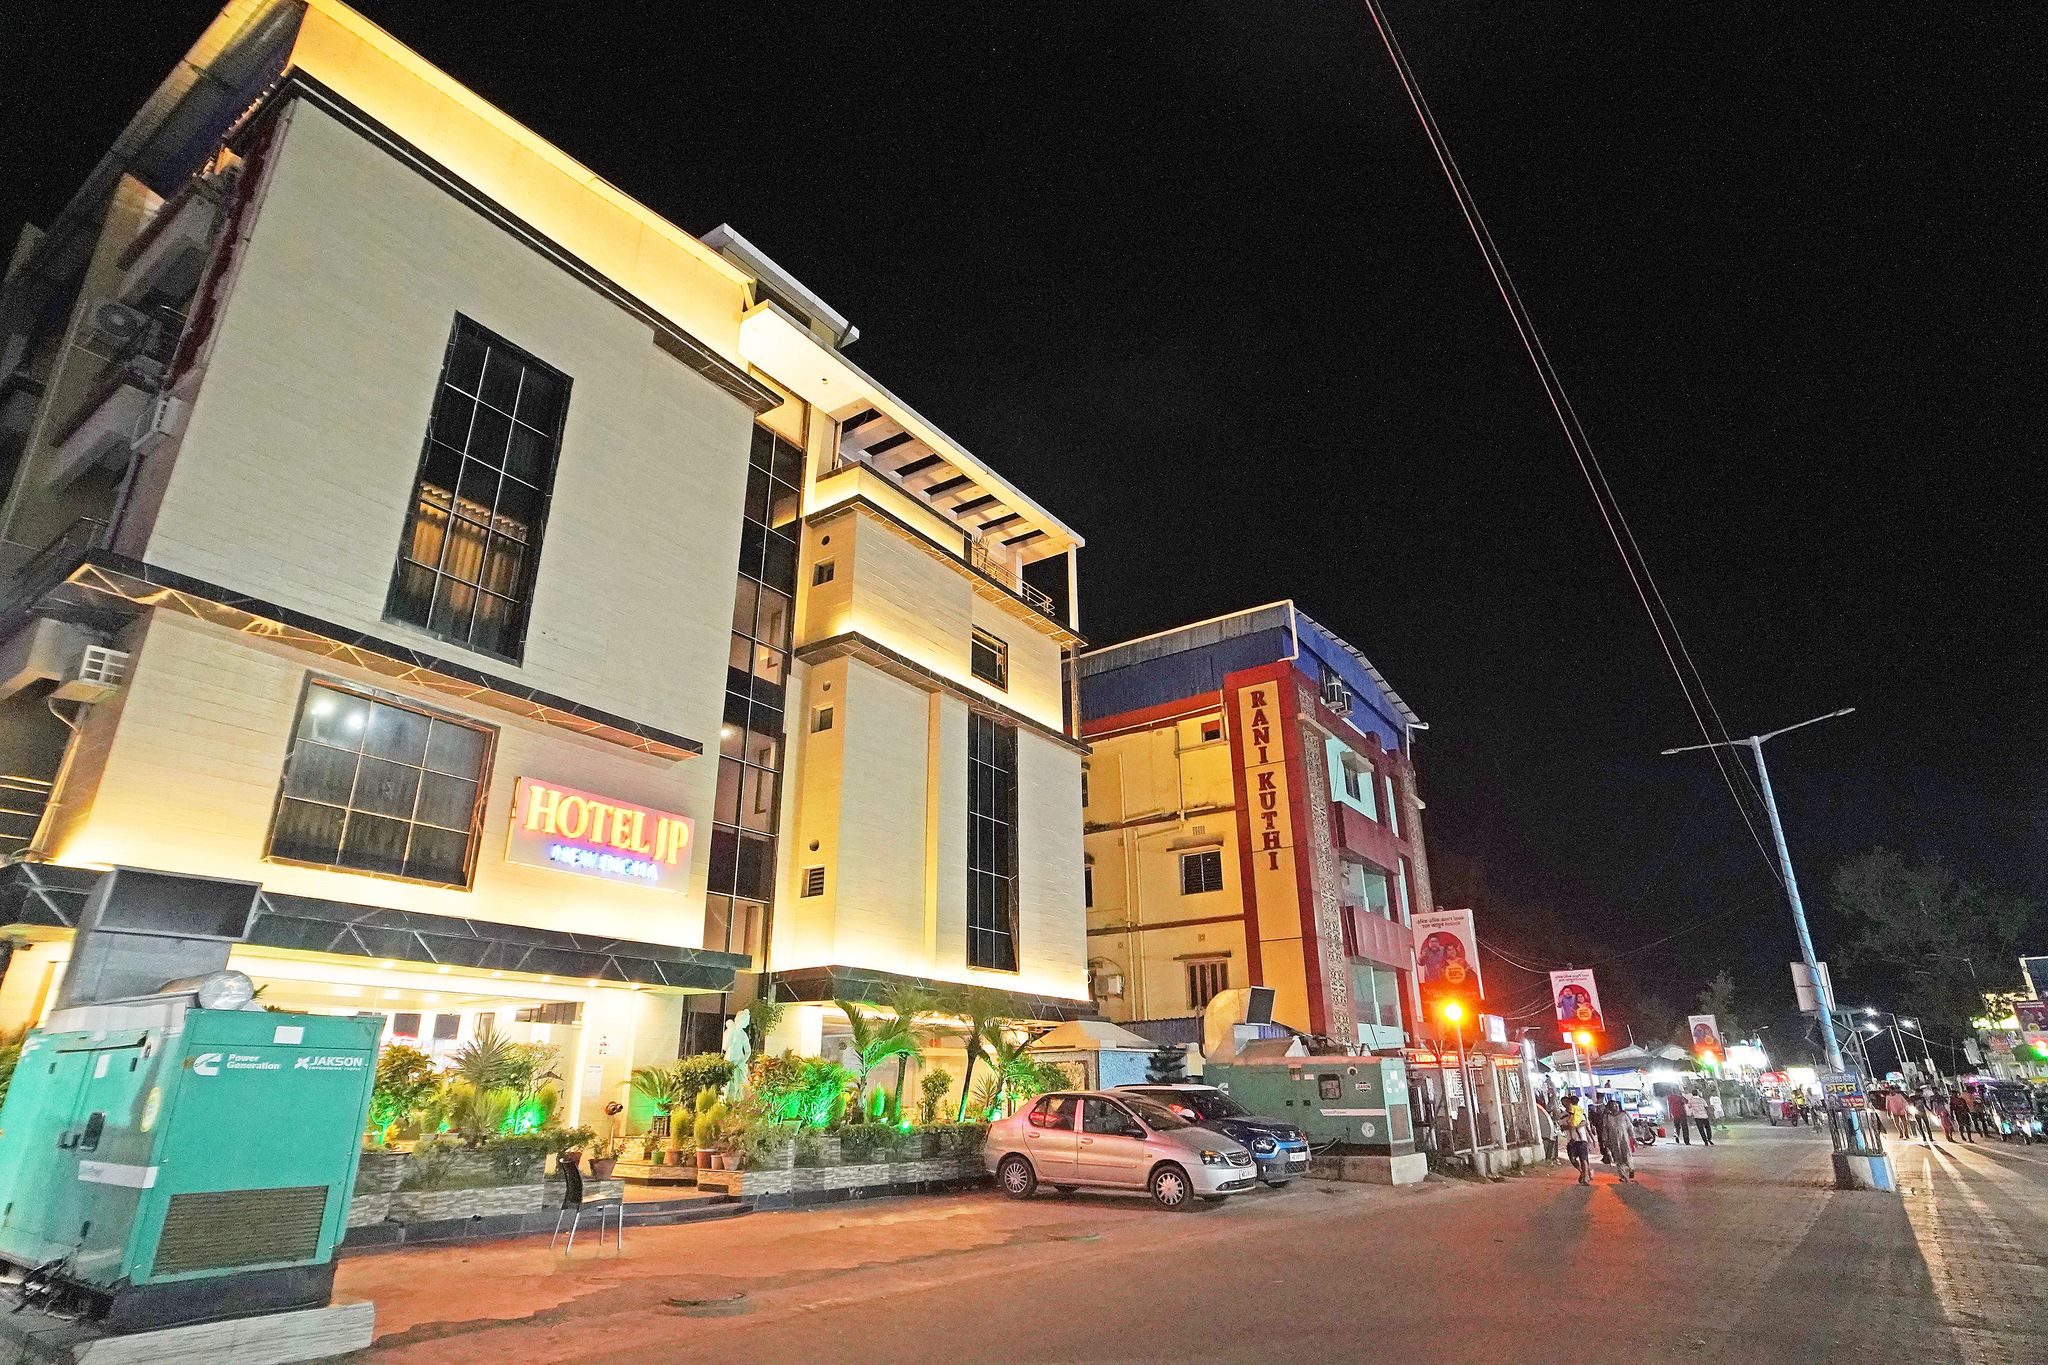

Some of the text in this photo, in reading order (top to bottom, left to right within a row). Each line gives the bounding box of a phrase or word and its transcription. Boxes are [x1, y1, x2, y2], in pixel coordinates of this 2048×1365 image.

[1250, 690, 1270, 764] RANI
[524, 785, 689, 865] HOTEL JP
[1258, 771, 1281, 870] KUTHI
[226, 1062, 281, 1070] Generation
[228, 1054, 260, 1062] Power
[308, 1056, 364, 1067] JAKSON
